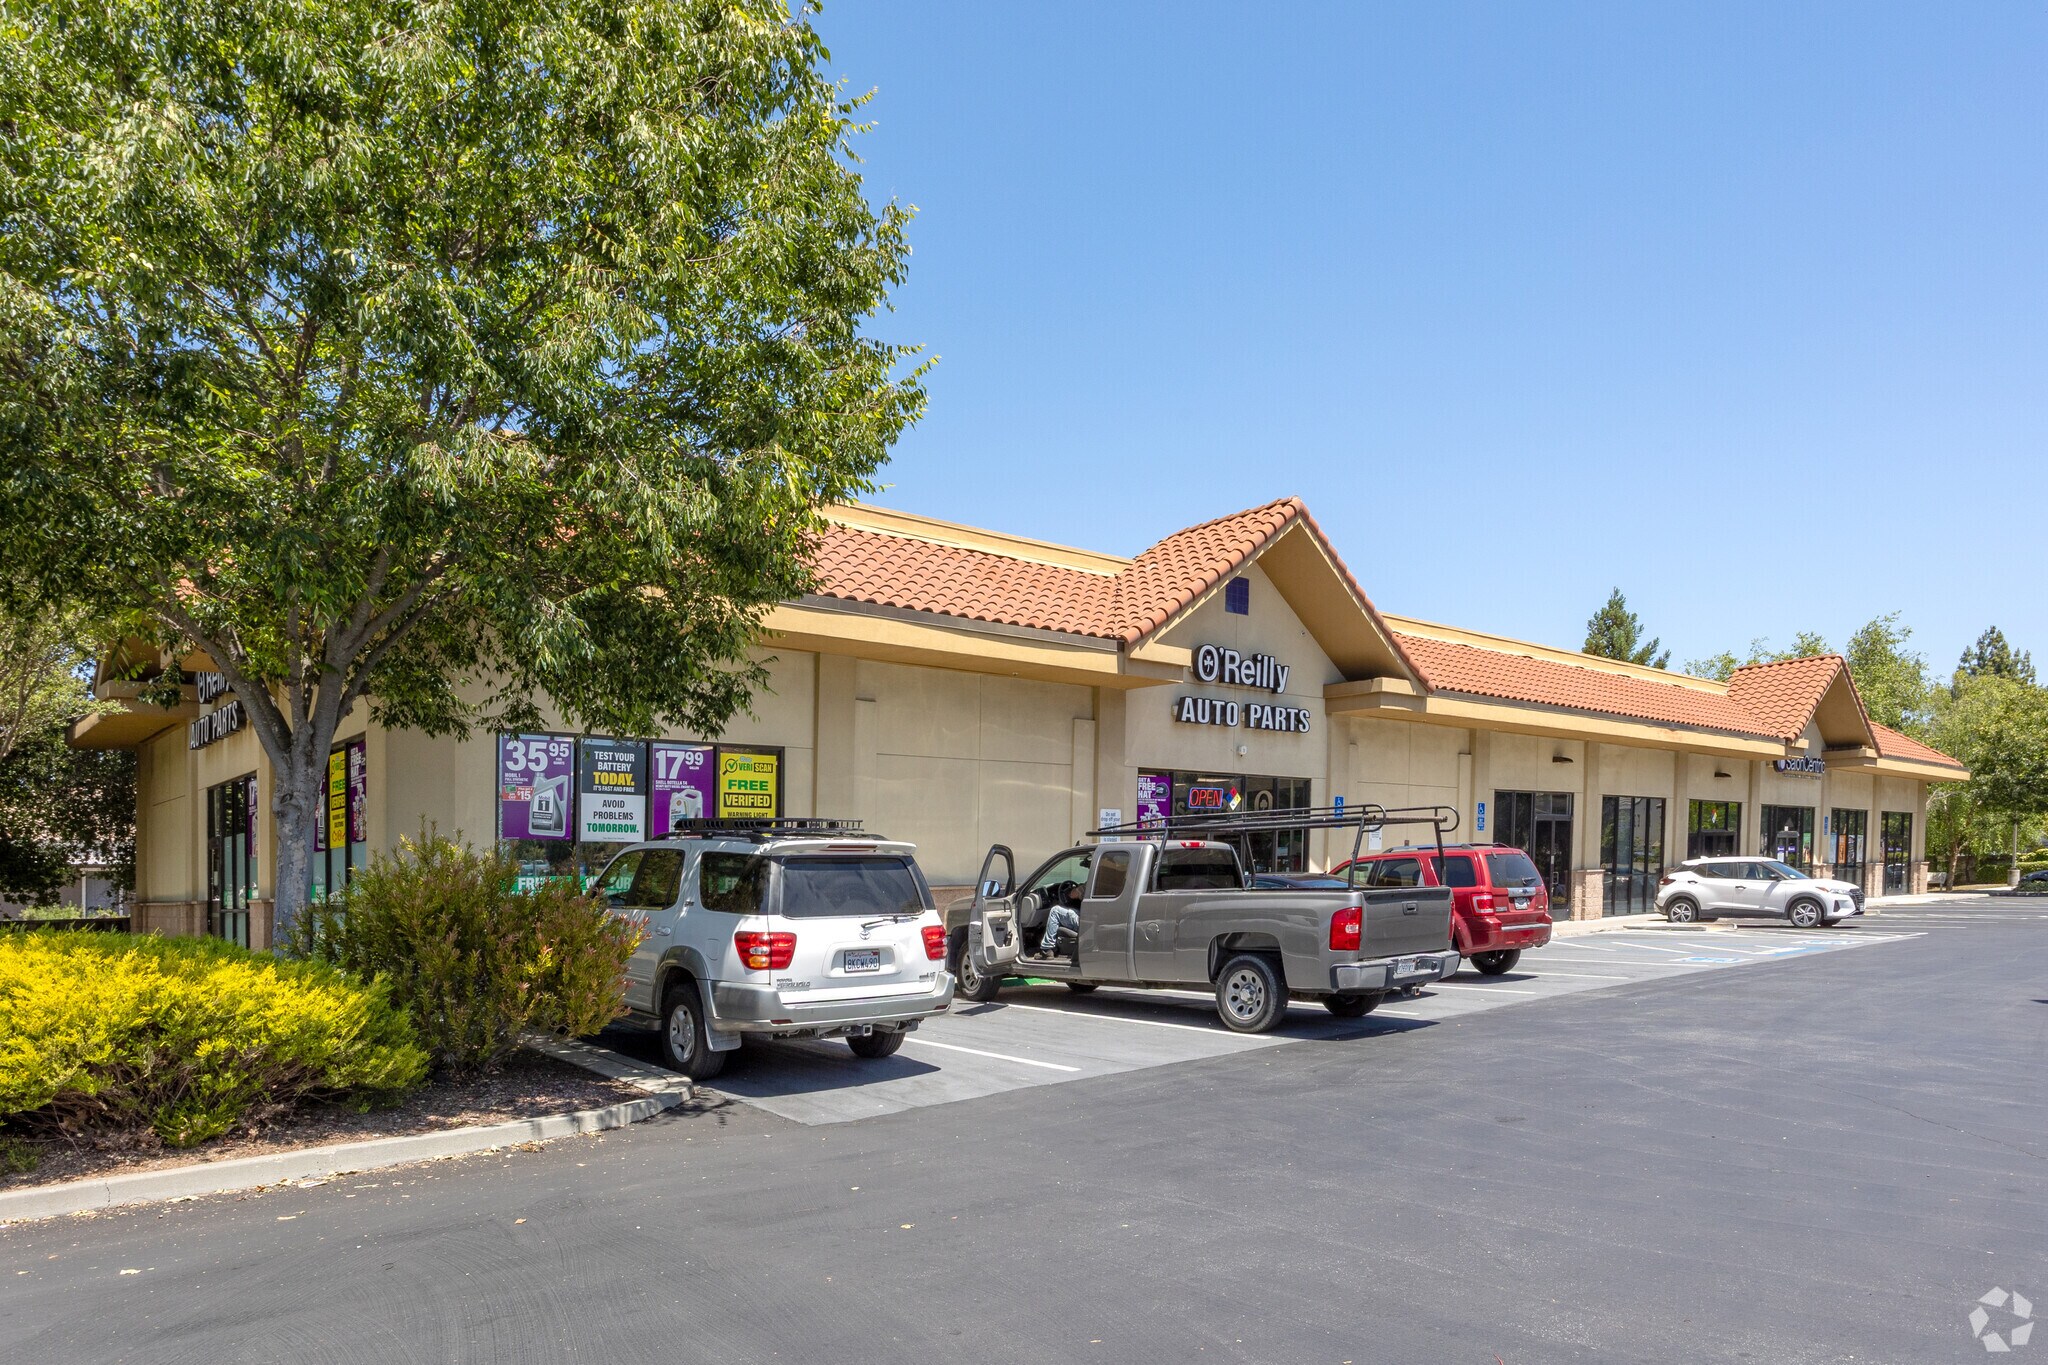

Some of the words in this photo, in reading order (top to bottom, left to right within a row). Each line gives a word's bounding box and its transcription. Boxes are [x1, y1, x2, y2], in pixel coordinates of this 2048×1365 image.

[1197, 644, 1289, 694] O'Reilly
[1181, 697, 1239, 727] AUTO
[1249, 704, 1311, 733] PARTS
[190, 715, 210, 750] AUTO
[212, 700, 238, 740] PARTS
[594, 750, 613, 762] TEST
[614, 752, 635, 762] YOUR
[597, 762, 632, 772] BATTERY
[754, 763, 773, 773] SCAN
[592, 771, 635, 786] TODAY.
[727, 779, 769, 791] FREE
[1138, 782, 1156, 791] FREE
[725, 794, 770, 807] VERIFIED
[1138, 790, 1152, 799] HAT
[1190, 788, 1222, 807] OPEN
[602, 799, 626, 809] AVOID
[593, 811, 634, 821] PROBLEMS
[586, 823, 640, 834] TOMORROW.
[847, 957, 878, 970] 8KCW490
